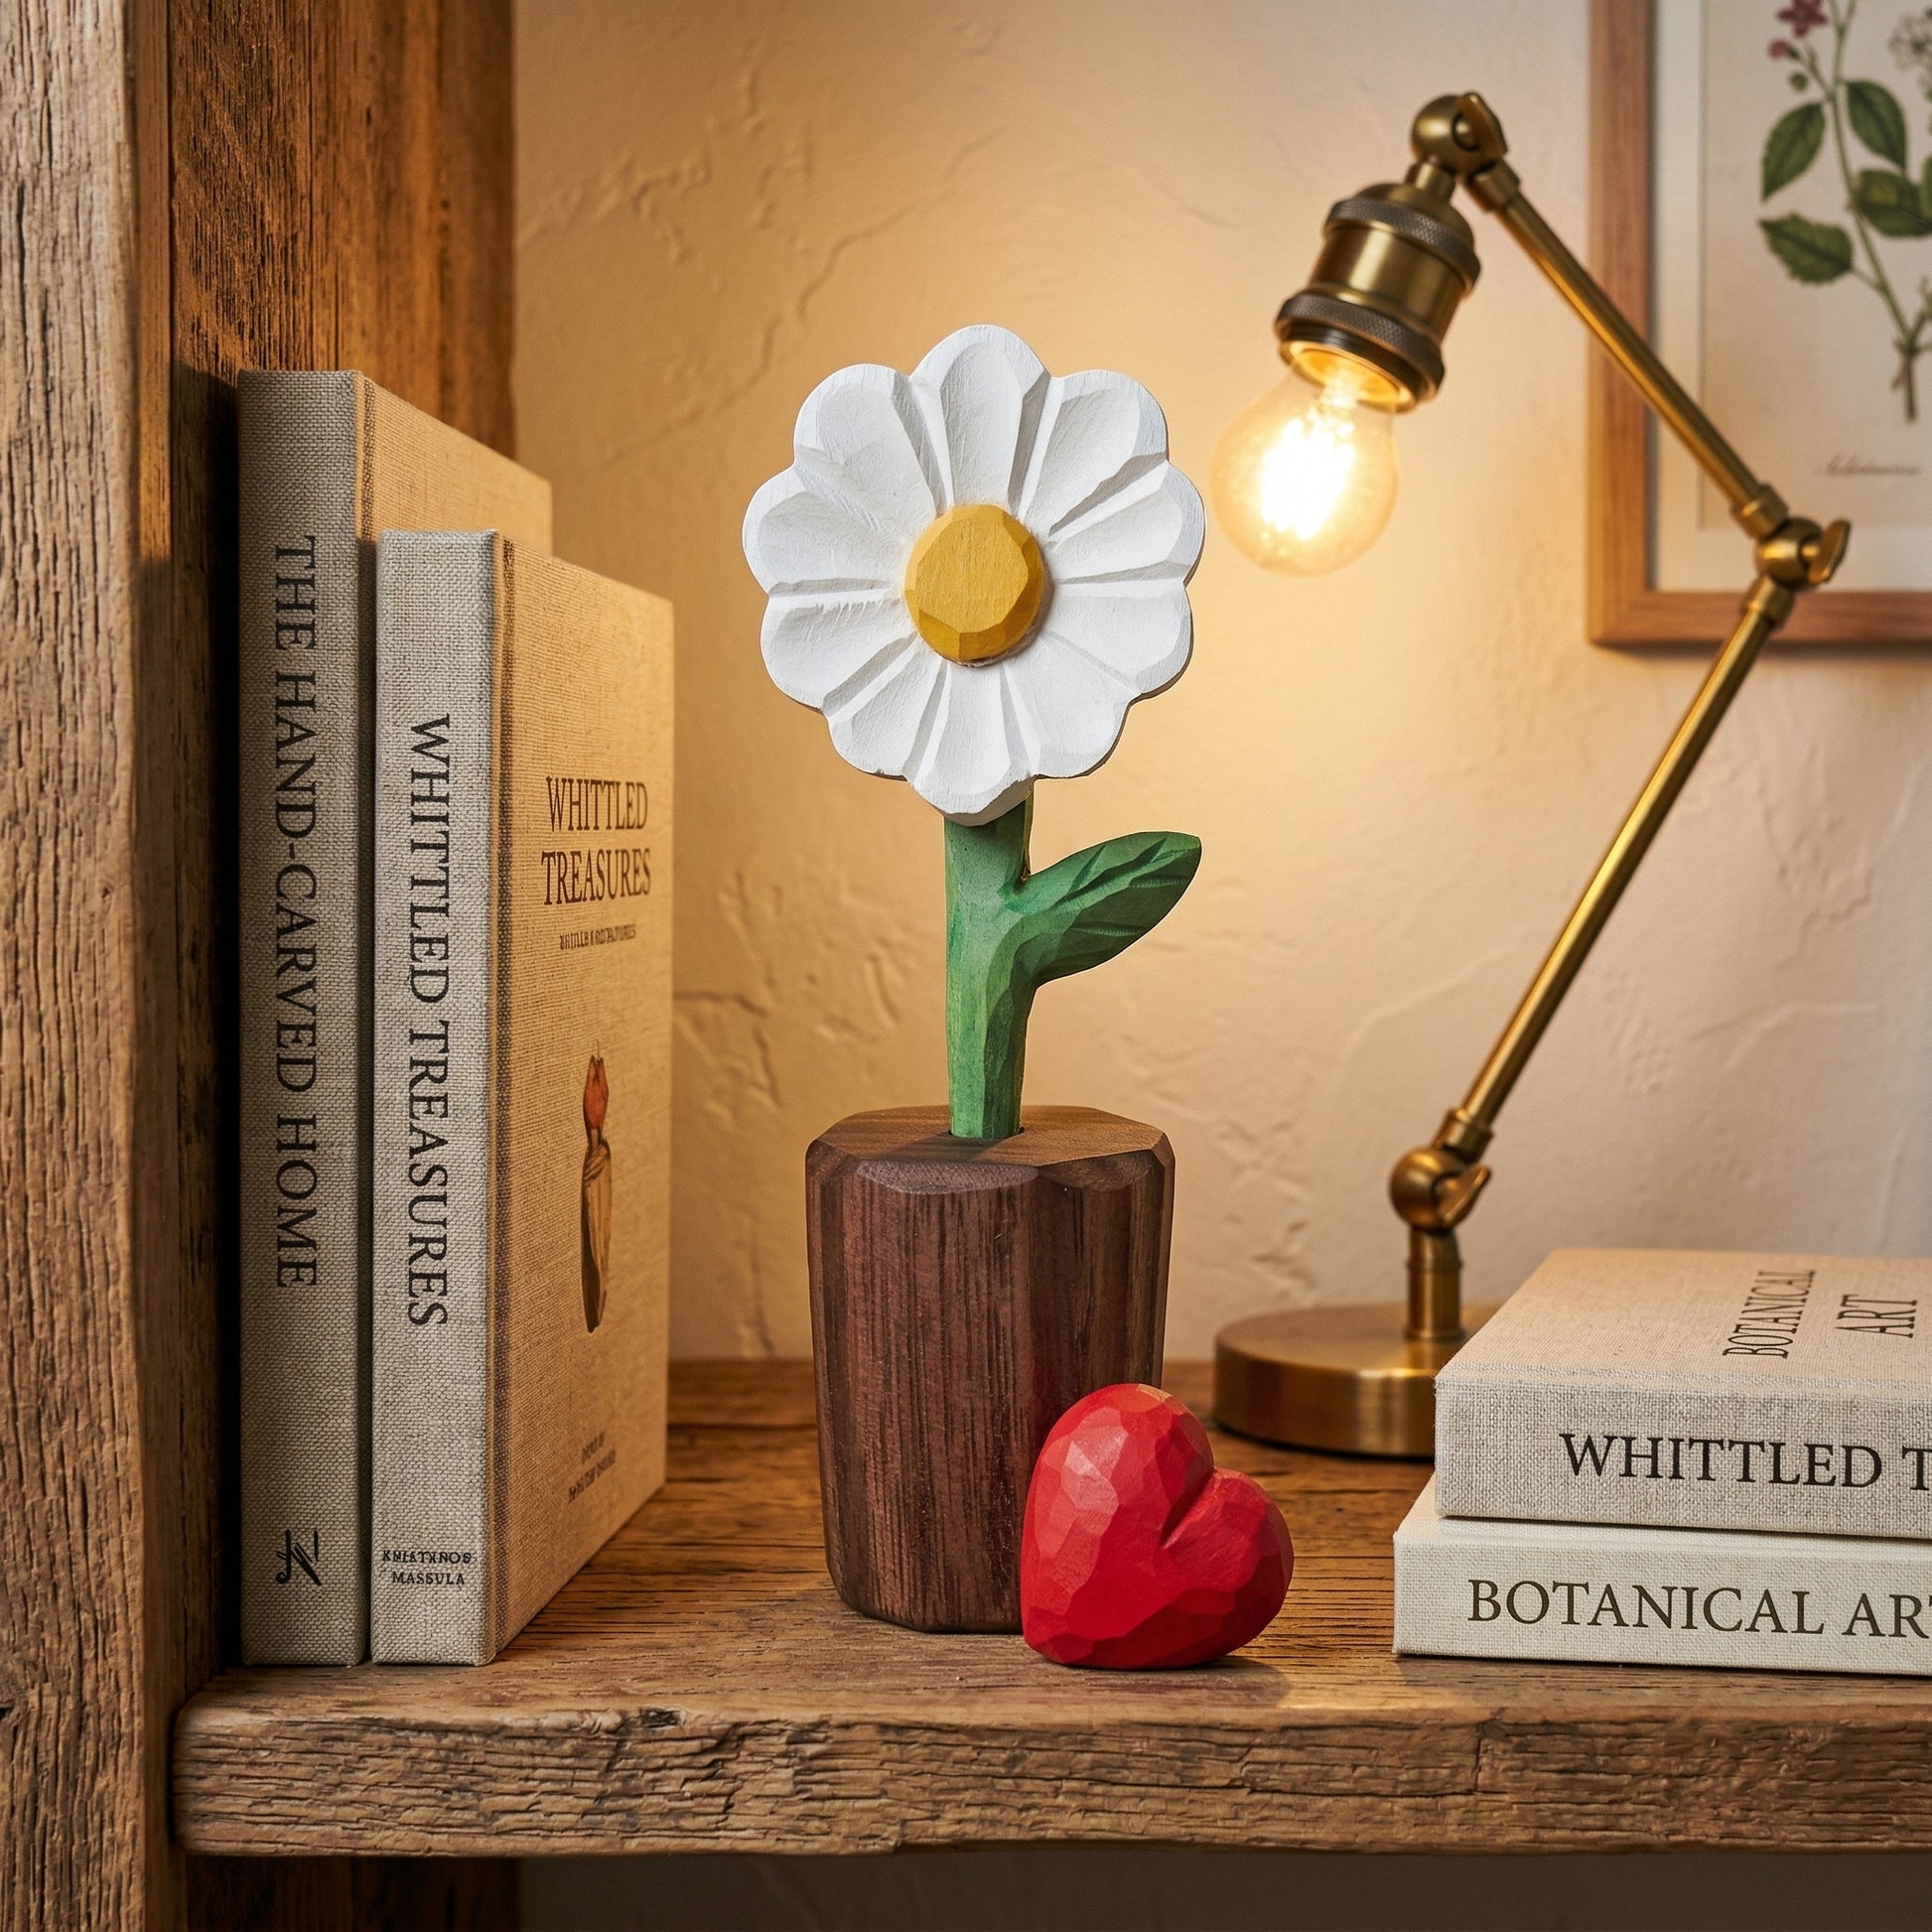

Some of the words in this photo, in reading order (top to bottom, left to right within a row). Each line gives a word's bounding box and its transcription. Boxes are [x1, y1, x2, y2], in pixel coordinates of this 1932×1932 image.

[275, 535, 317, 651] THE
[545, 775, 649, 832] WHITTLED
[275, 670, 318, 1093] HAND-CARVED
[410, 713, 450, 1004] WHITTLED
[541, 848, 651, 905] TREASURES
[275, 1113, 318, 1288] HOME
[408, 1019, 450, 1326] TREASURES
[1722, 1270, 1816, 1359] BOTANICAL
[1835, 1294, 1917, 1338] ART
[1559, 1433, 1882, 1488] WHITTLED
[391, 1571, 465, 1585] MASSULA
[1467, 1579, 1825, 1635] BOTANICAL
[1842, 1593, 1932, 1639] AR
